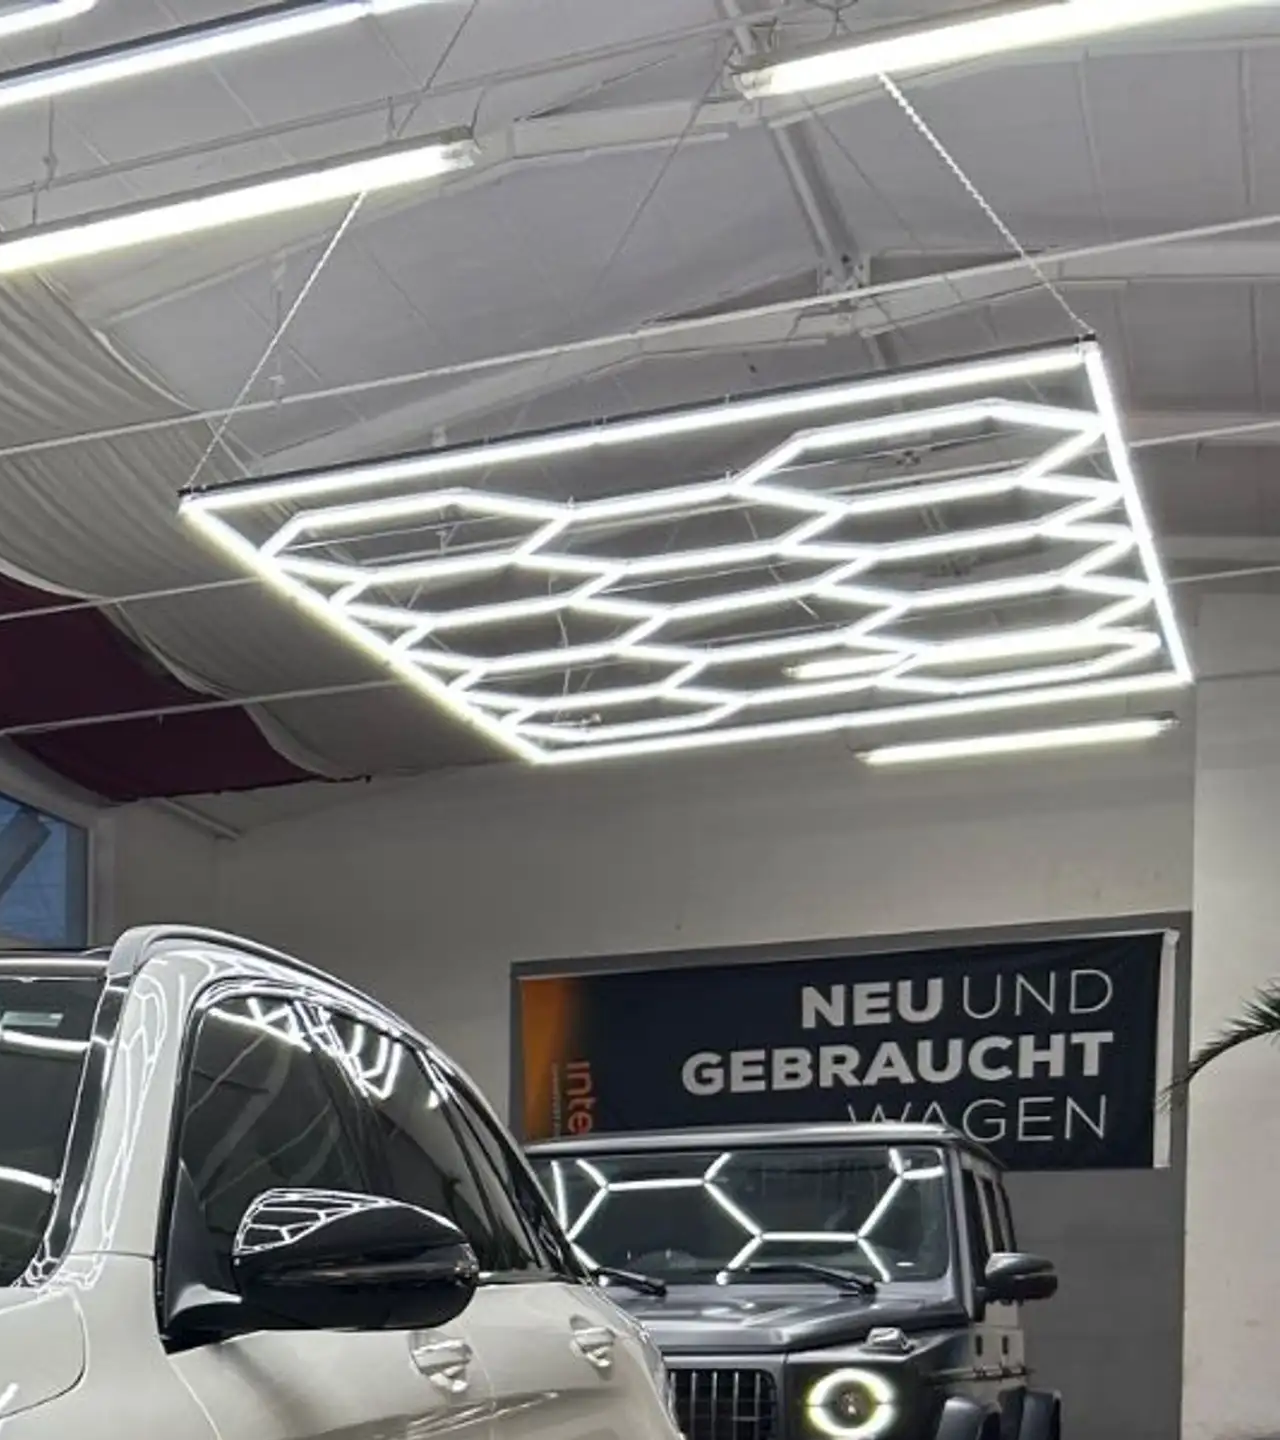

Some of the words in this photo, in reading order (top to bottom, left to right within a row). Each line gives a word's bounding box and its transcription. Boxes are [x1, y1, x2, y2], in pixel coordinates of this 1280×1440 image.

[801, 978, 944, 1028] NEU
[962, 969, 1114, 1019] UND
[681, 1032, 1114, 1095] GEBRAUCHT
